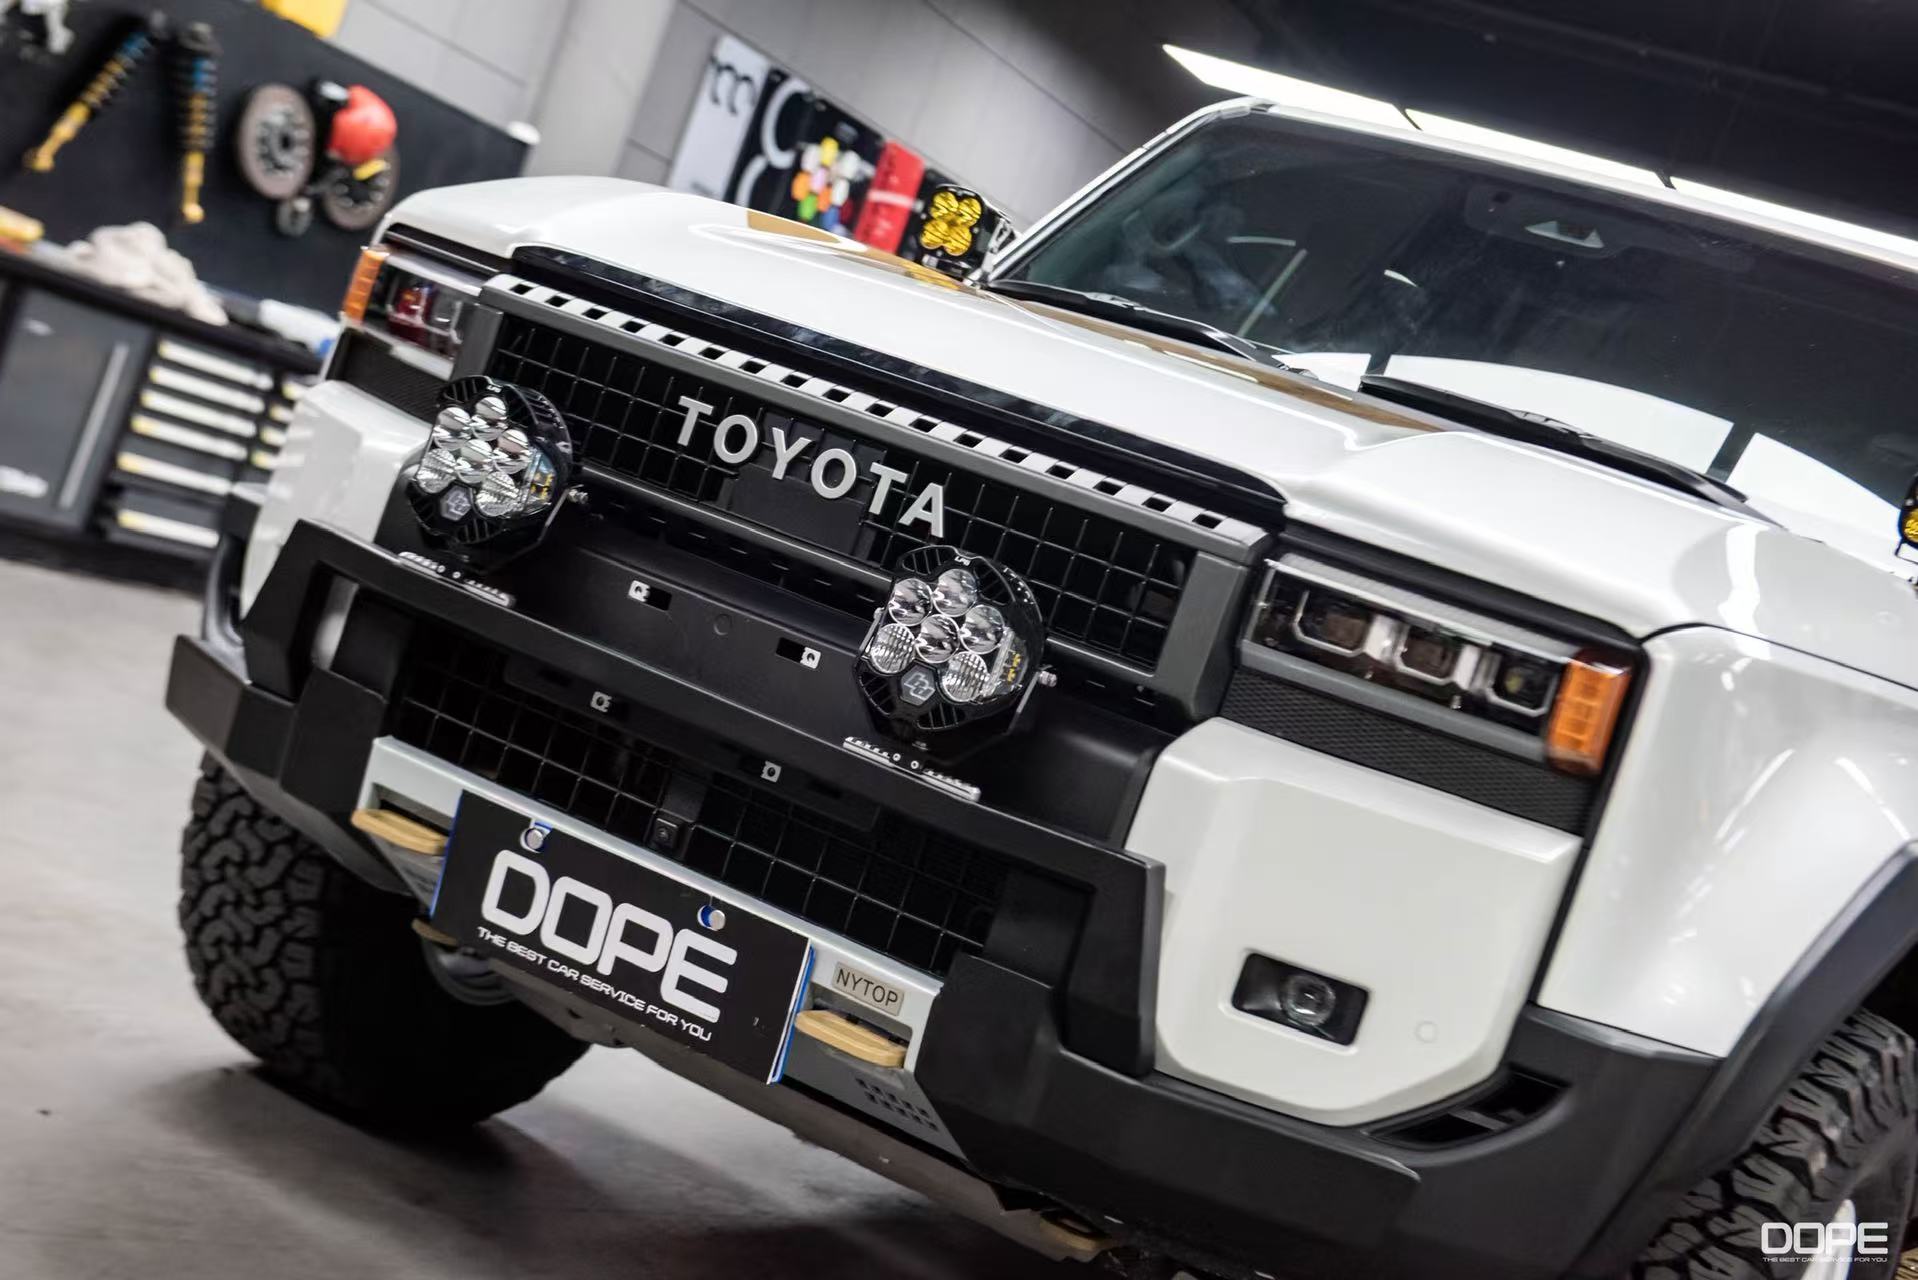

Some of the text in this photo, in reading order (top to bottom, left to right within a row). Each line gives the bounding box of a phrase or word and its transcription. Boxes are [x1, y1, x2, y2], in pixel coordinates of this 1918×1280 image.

[677, 395, 944, 538] TOYOTA
[477, 926, 712, 1041] THE BEST CAR SERVICE FOR YOU
[481, 849, 738, 1023] DOPE
[836, 968, 898, 1006] NYTOP
